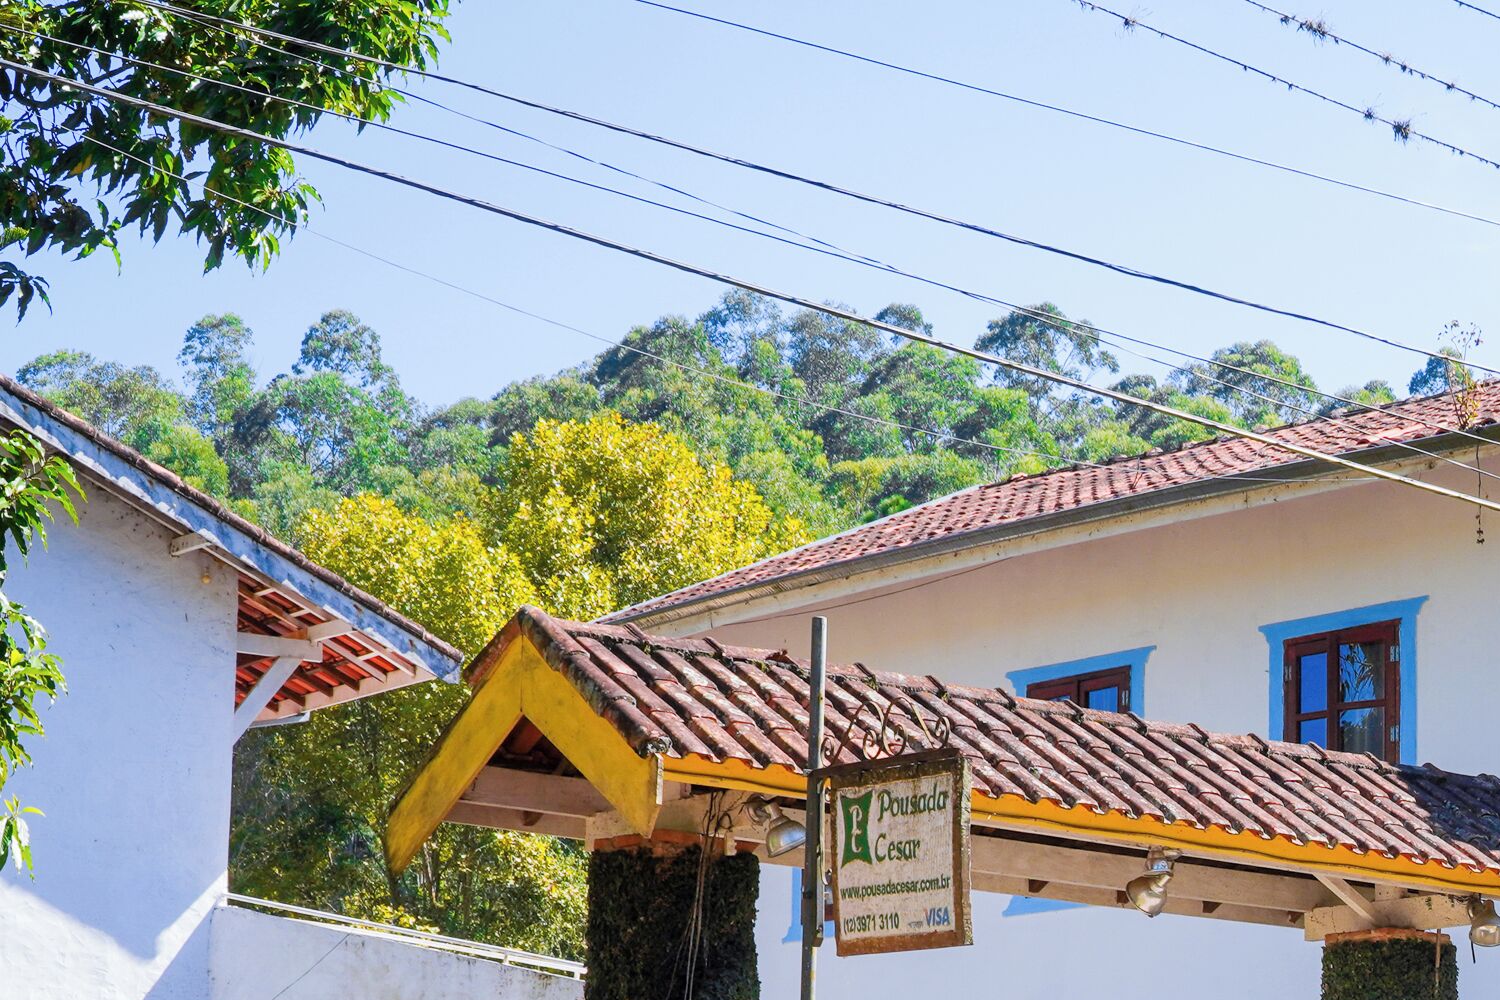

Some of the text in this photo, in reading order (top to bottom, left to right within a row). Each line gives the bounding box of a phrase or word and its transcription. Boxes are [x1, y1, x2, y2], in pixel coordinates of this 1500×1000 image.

[877, 783, 948, 822] Pousada
[874, 832, 920, 862] Cesar
[840, 874, 950, 901] www.pousadacesar.com.br
[878, 912, 900, 932] 3110
[924, 906, 950, 928] VISA
